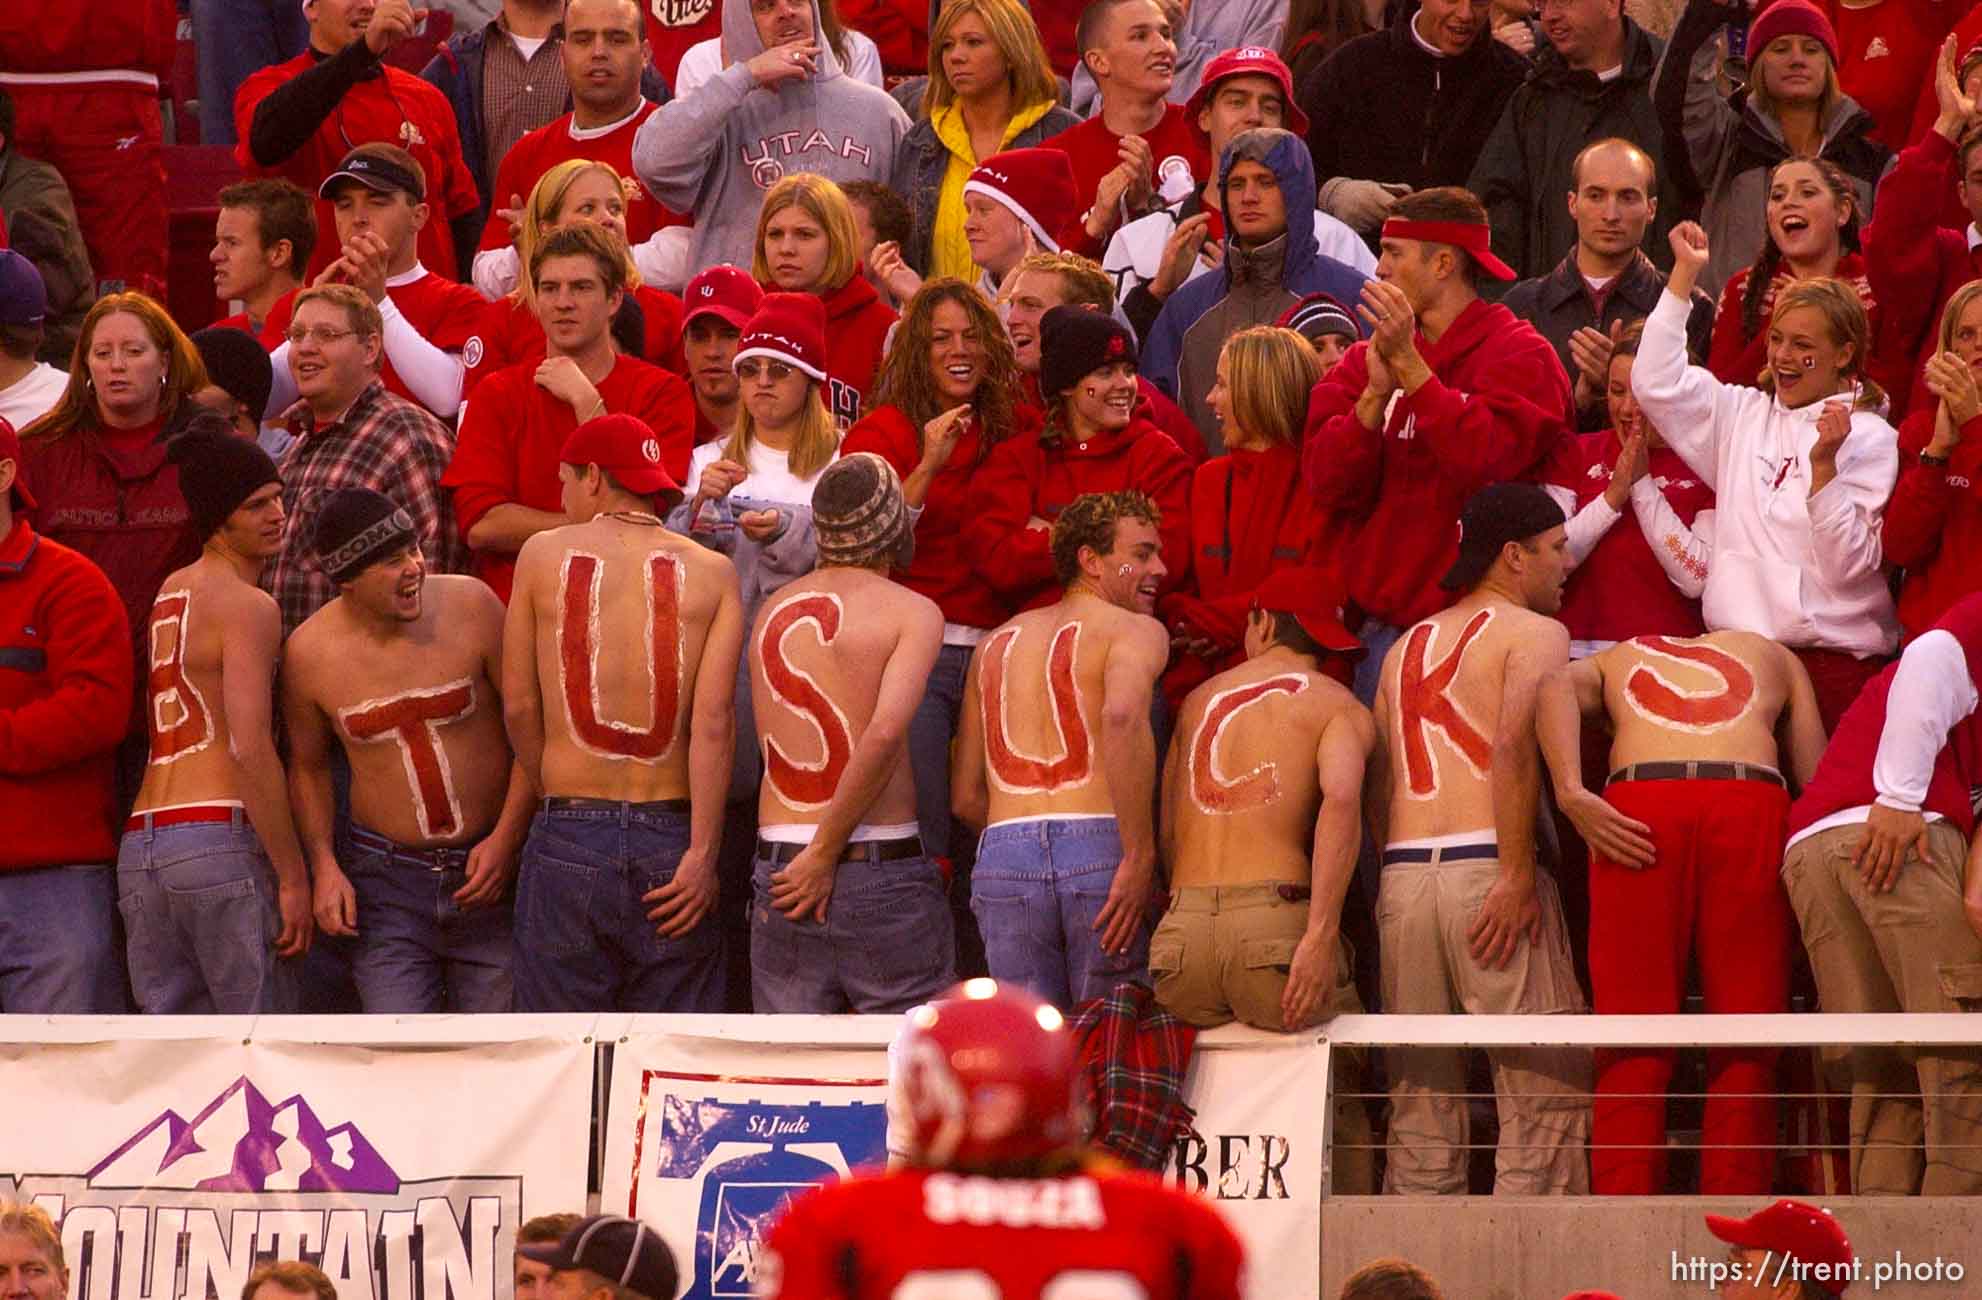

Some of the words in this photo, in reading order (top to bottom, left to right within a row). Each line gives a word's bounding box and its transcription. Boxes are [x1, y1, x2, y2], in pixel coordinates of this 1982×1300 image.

[740, 128, 872, 168] UTAH
[742, 333, 803, 353] UTAH
[338, 677, 476, 839] T
[556, 550, 686, 765] U
[759, 591, 855, 811] S
[978, 621, 1094, 794] U
[1189, 672, 1309, 815] C
[1397, 607, 1495, 800] K
[746, 1115, 766, 1133] St
[763, 1115, 810, 1137] Jude
[30, 1194, 502, 1300] OUNTAIN
